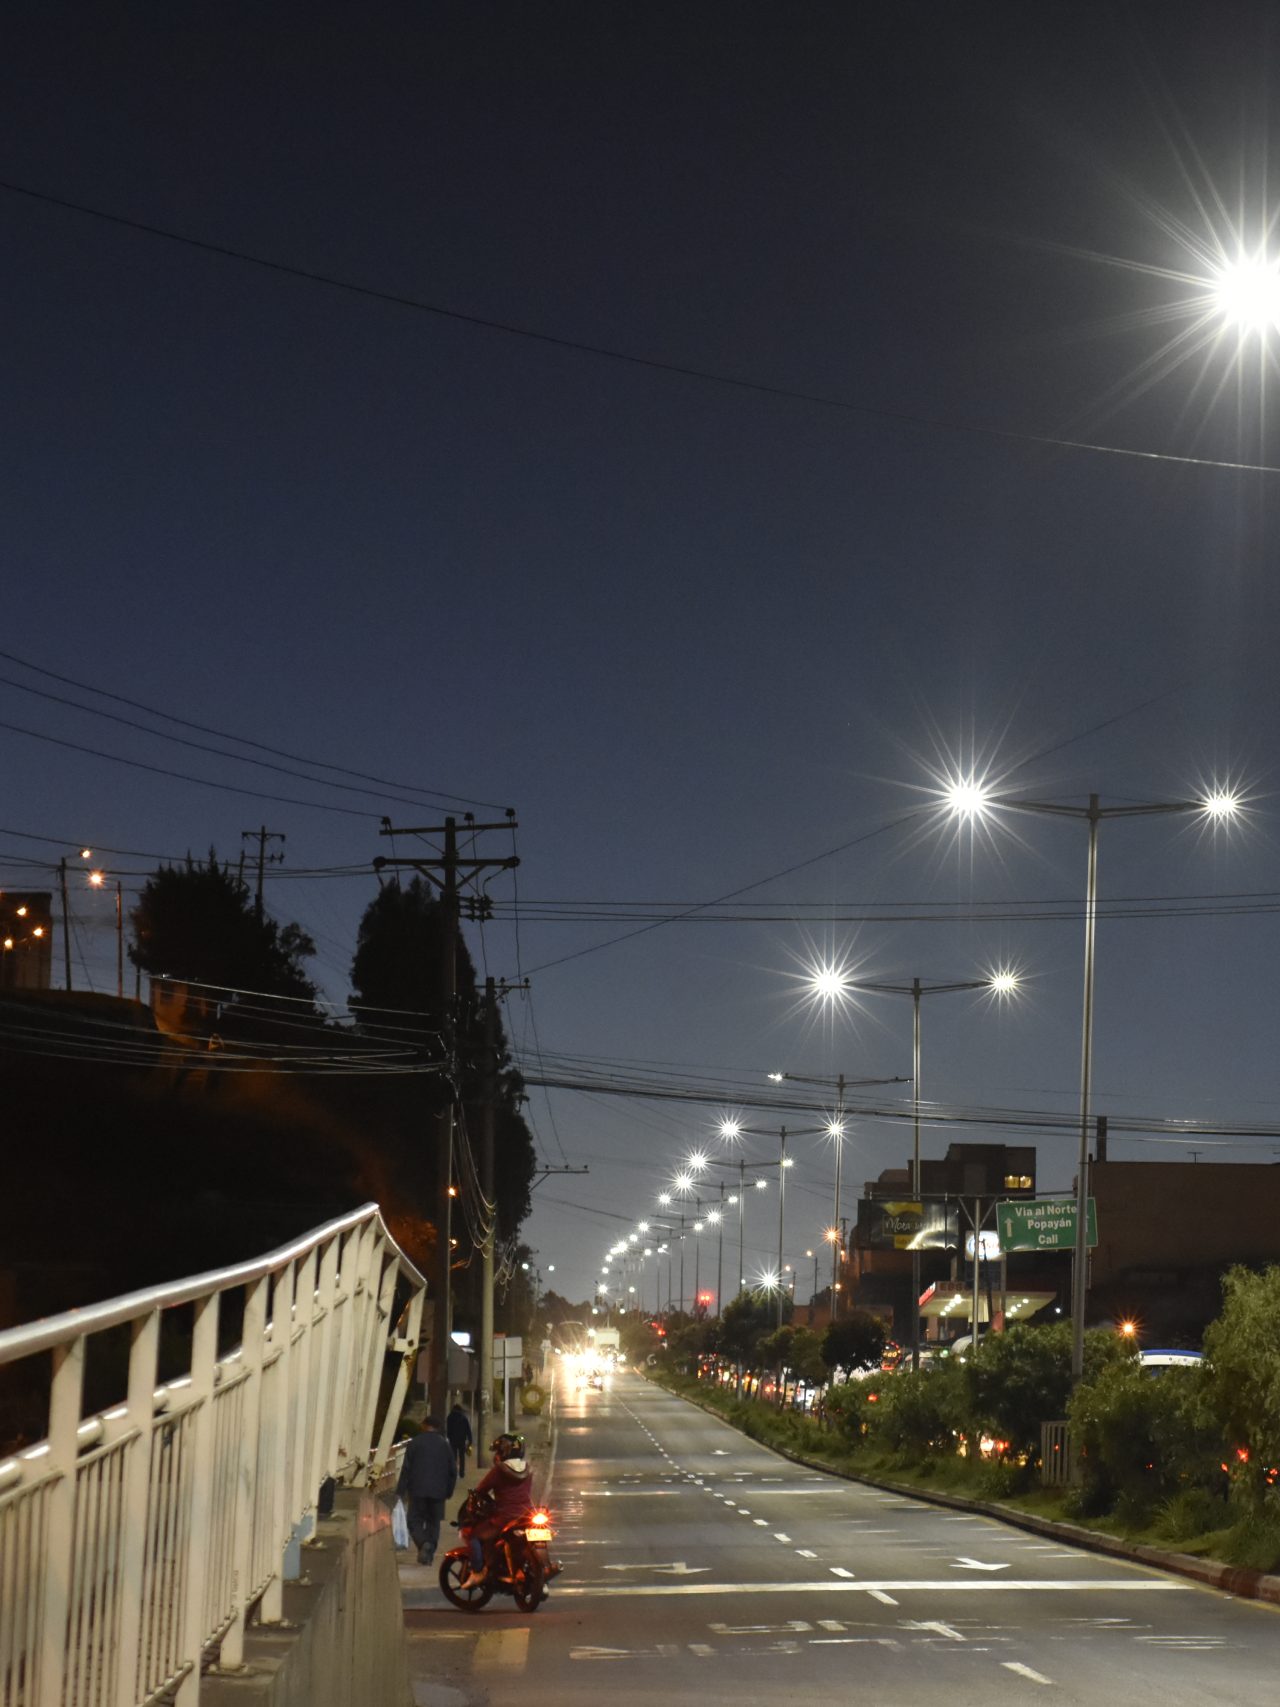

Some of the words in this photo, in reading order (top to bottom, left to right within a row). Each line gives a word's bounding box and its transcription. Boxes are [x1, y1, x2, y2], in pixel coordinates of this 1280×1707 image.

[1035, 1206, 1045, 1216] al
[1047, 1205, 1077, 1215] Norte
[1027, 1217, 1072, 1231] Popayán
